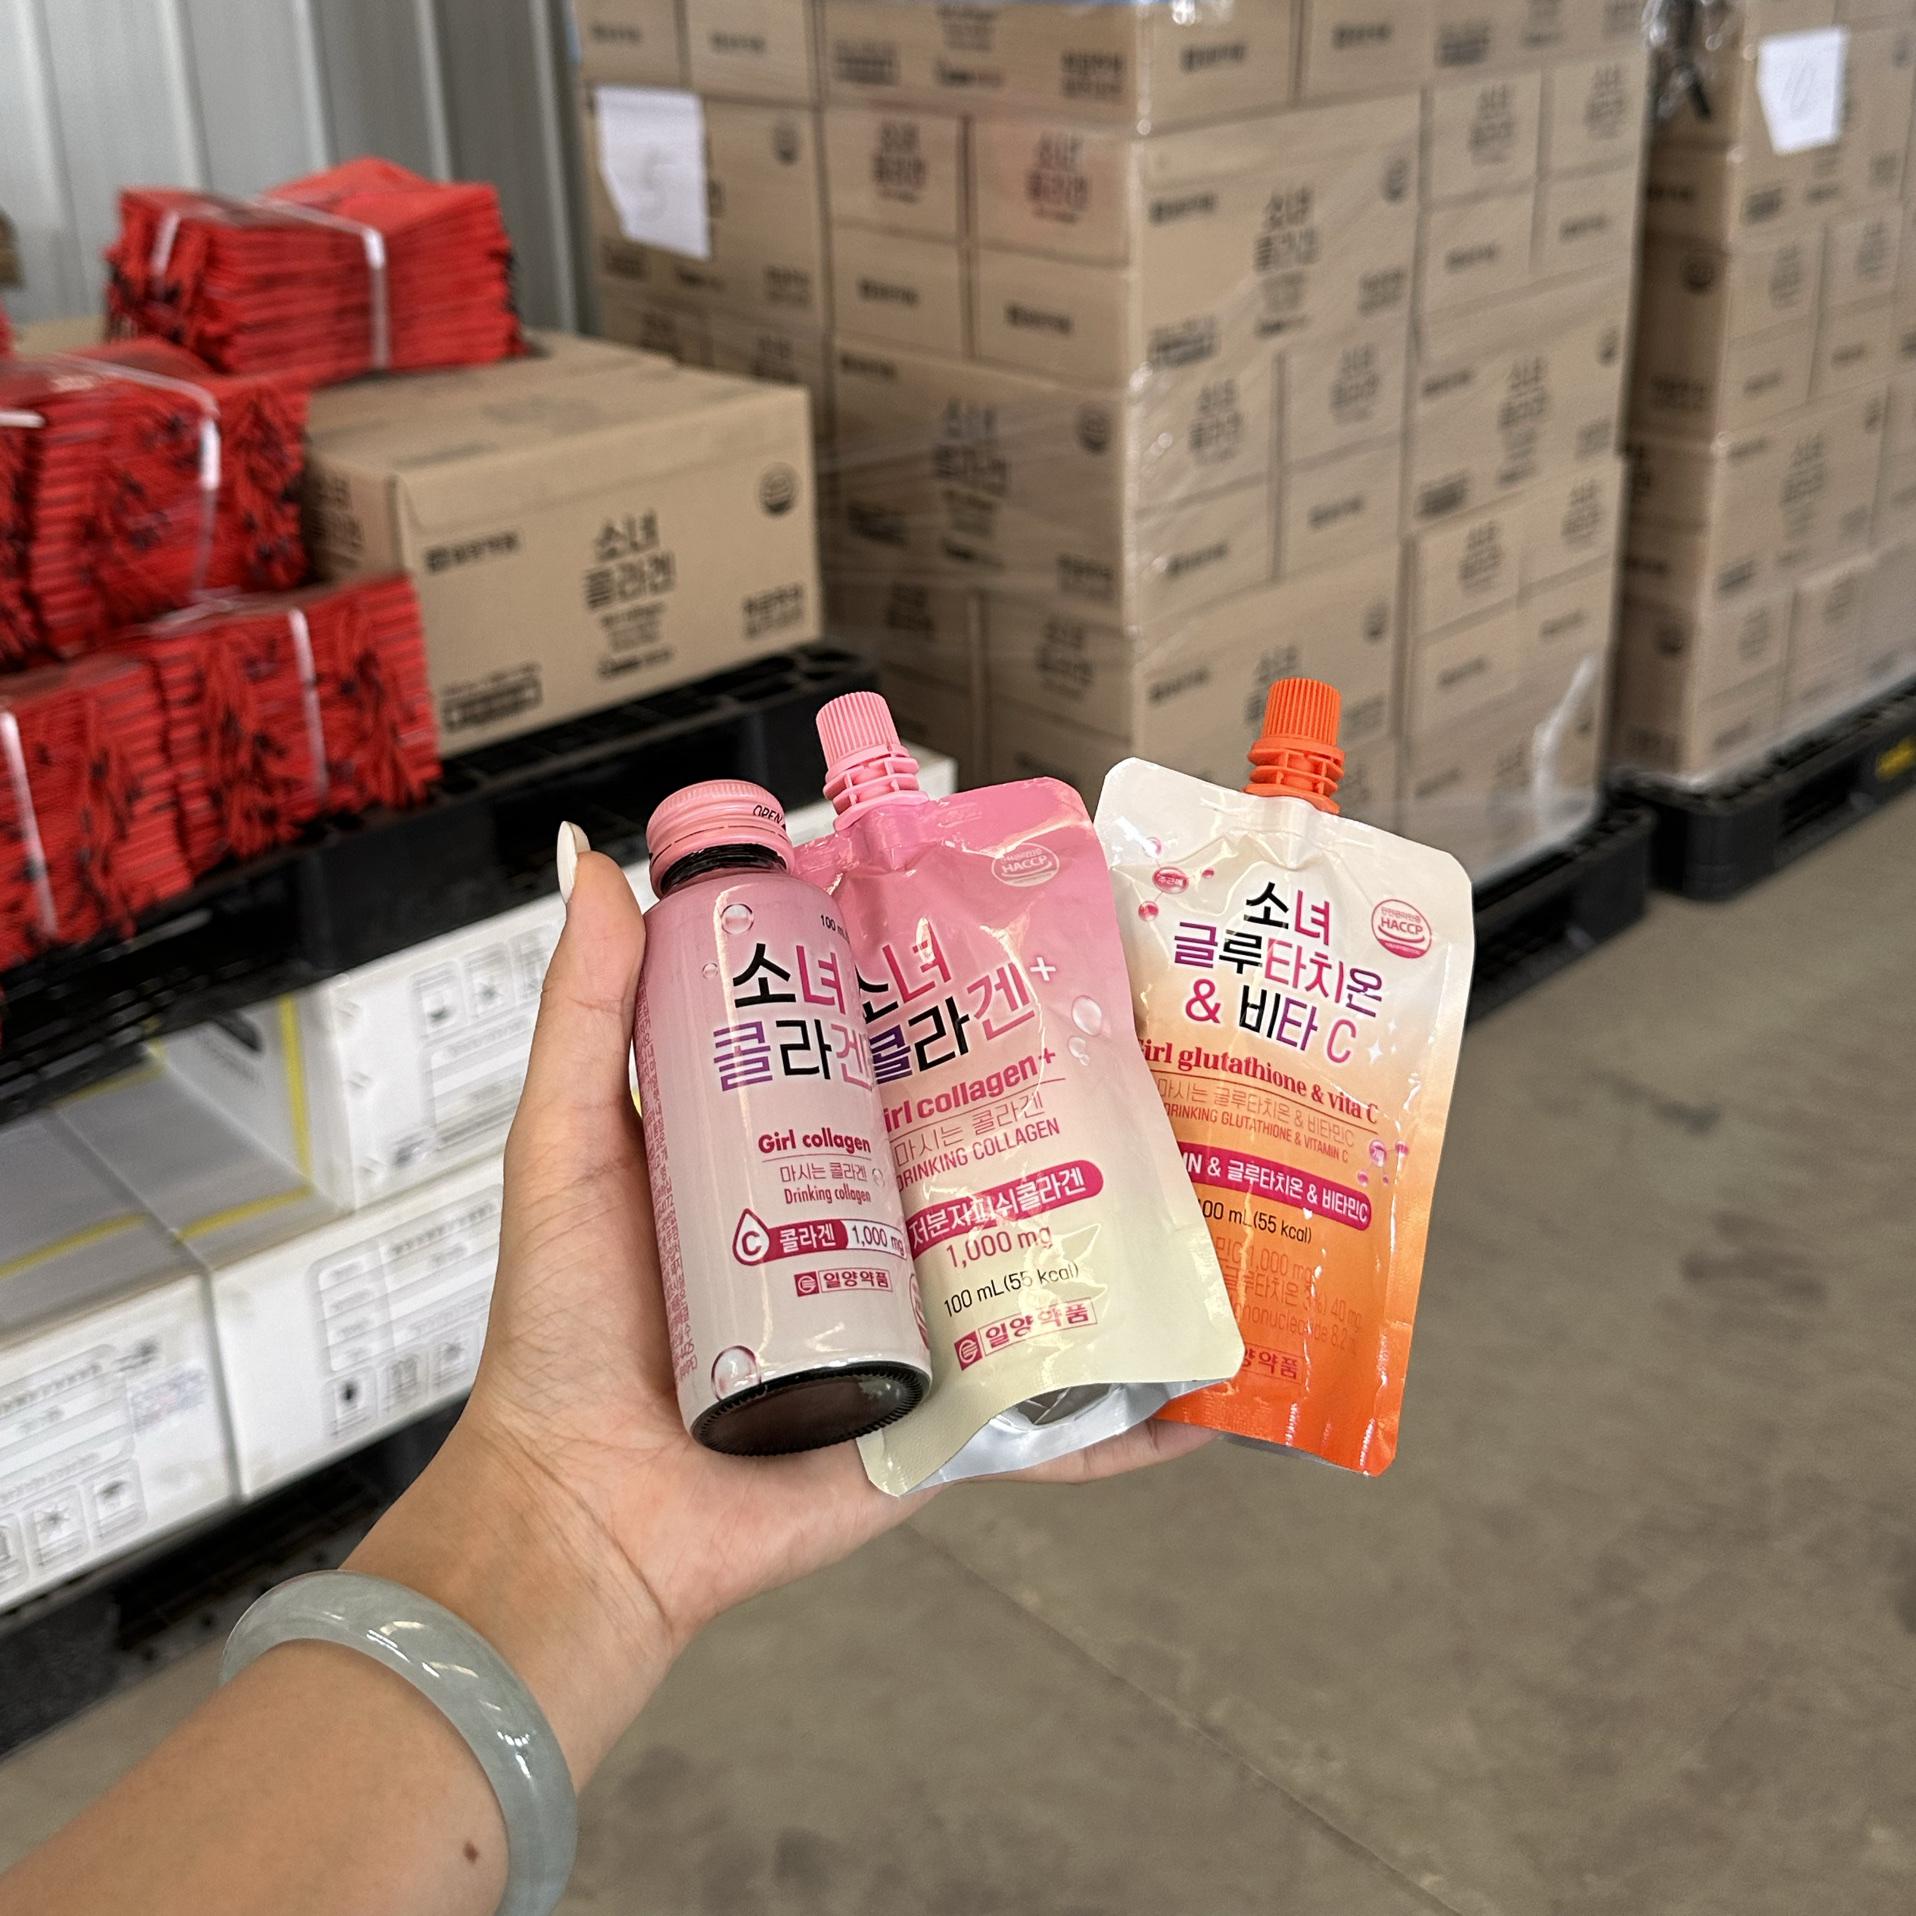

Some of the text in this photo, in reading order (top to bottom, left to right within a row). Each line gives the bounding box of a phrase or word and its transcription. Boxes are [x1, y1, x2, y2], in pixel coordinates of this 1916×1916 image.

[752, 804, 783, 824] OPEN
[1001, 855, 1048, 874] HACCP
[820, 914, 836, 931] 100
[1244, 881, 1330, 946] 소녀
[1381, 916, 1424, 936] HACCP
[733, 942, 847, 1015] 소녀
[1174, 921, 1383, 1018] 글루타치온
[1184, 978, 1357, 1064] & 비타 C
[713, 1018, 874, 1092] 콜라겐
[1137, 1038, 1379, 1125] irl glutathione & vita C
[1157, 1078, 1208, 1103] 마시는
[1214, 1086, 1291, 1124] 글루타치온
[1295, 1109, 1304, 1128] &
[758, 1127, 872, 1155] Girl collagen
[894, 1093, 1046, 1168] 마시는 콜라겐
[1221, 1111, 1293, 1143] GLUTATHIONE
[1303, 1134, 1341, 1161] VITAMIN
[1342, 1149, 1350, 1164] C
[780, 1162, 868, 1183] 마시는 콜라겐
[896, 1117, 1060, 1193] DRINKING COLLAGEN
[784, 1182, 872, 1206] Drinking collagen
[1207, 1157, 1221, 1177] &
[1227, 1159, 1304, 1200] 글루타치온
[1306, 1183, 1318, 1205] &
[1322, 1188, 1368, 1223] 비타민C
[741, 1230, 761, 1256] C
[779, 1223, 906, 1257] 콜라겐 1,000 mg
[1198, 1198, 1225, 1220] 00
[1280, 1220, 1313, 1245] kcal)
[946, 1226, 1053, 1268] 1,000 mg
[822, 1269, 890, 1290] 일양약품
[943, 1289, 973, 1318] 100
[1038, 1262, 1080, 1286] kcal)
[985, 1304, 1090, 1349] 일양약품
